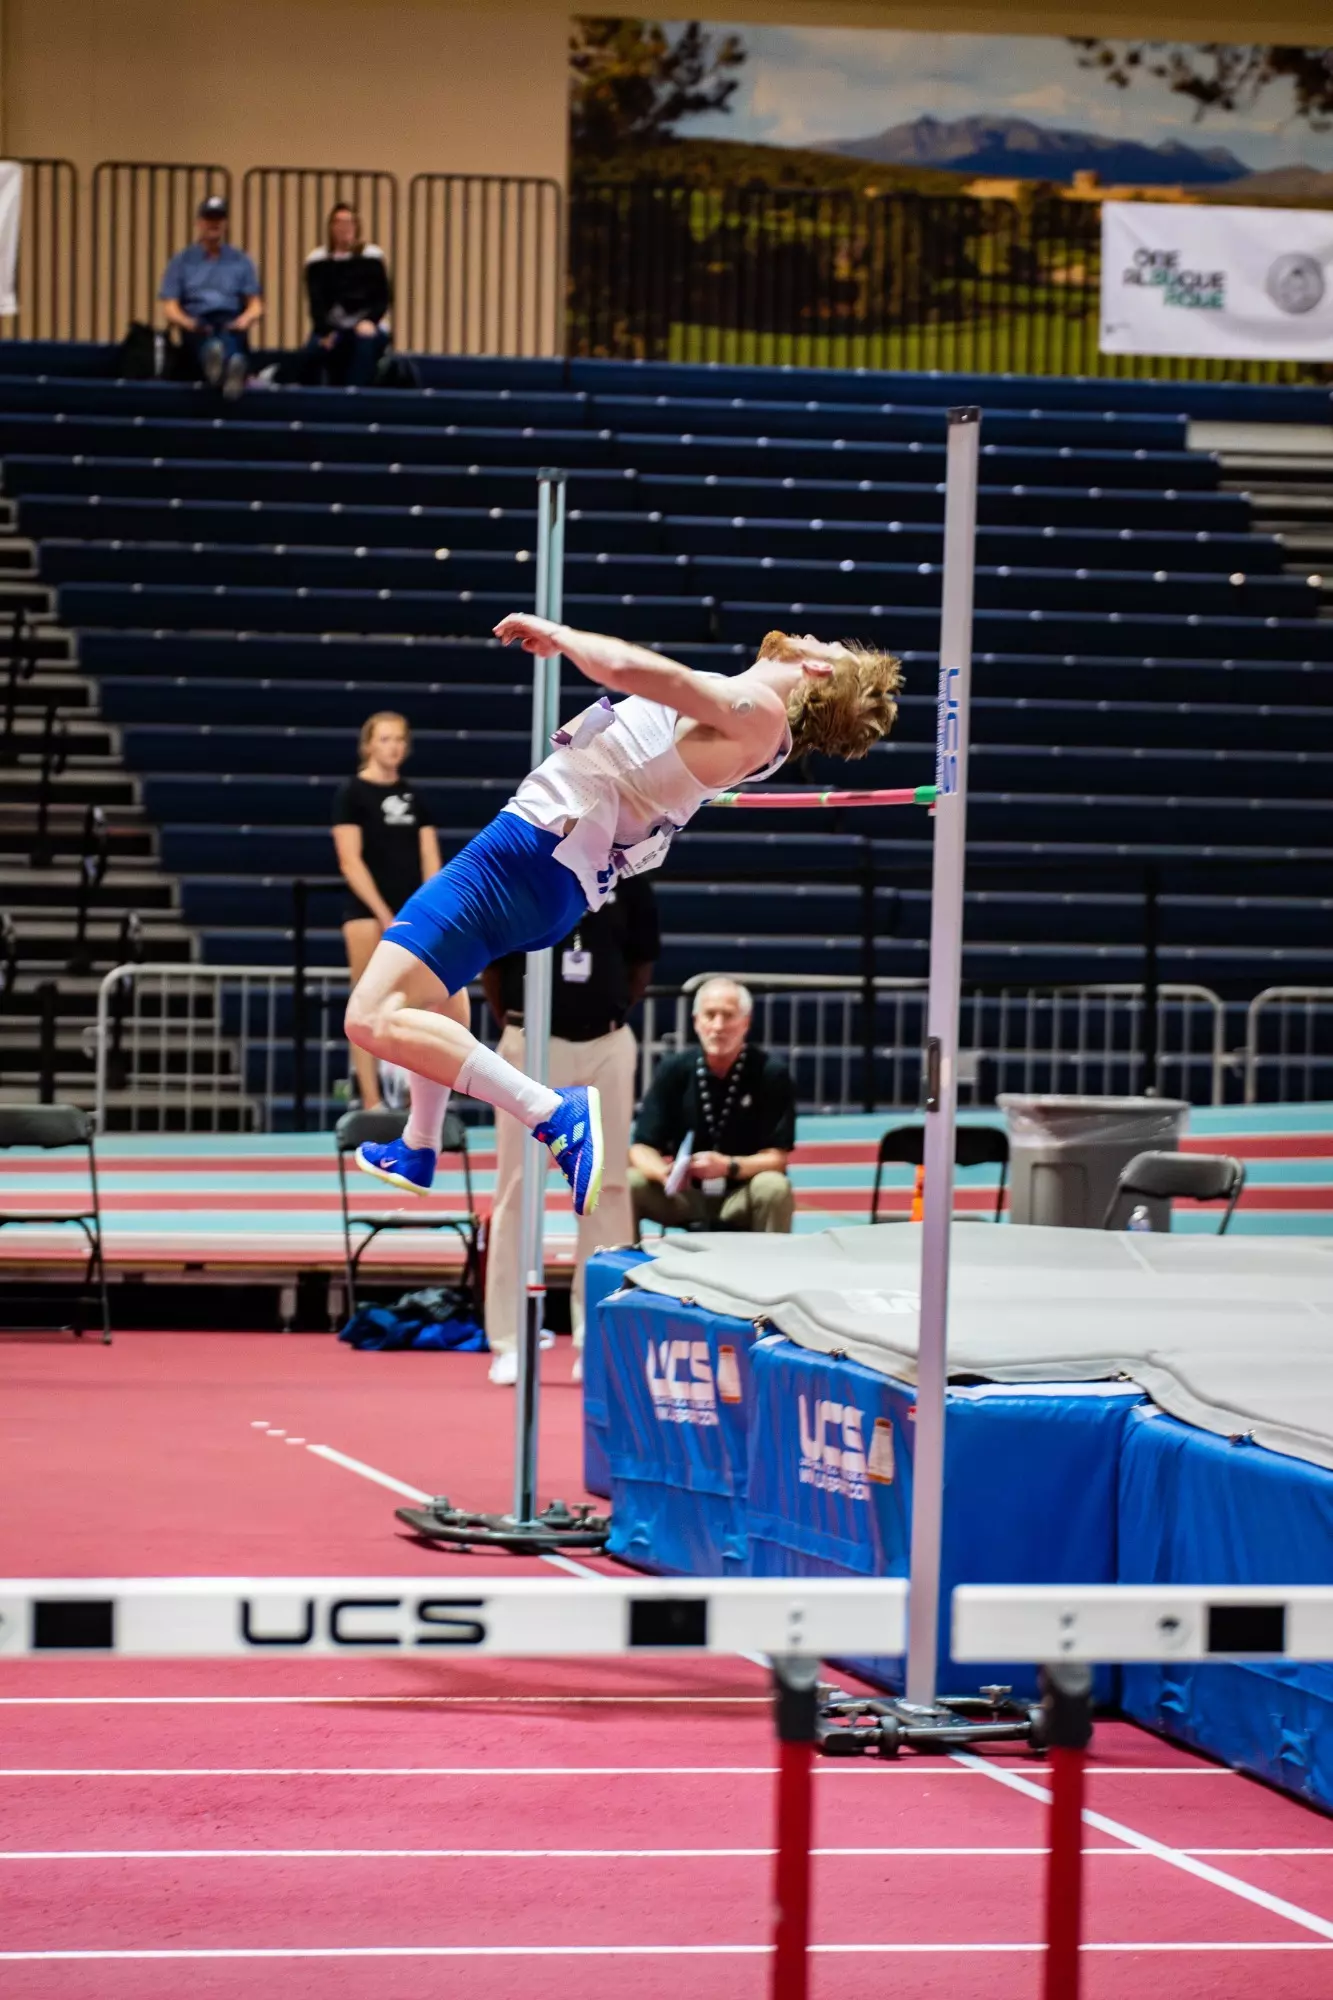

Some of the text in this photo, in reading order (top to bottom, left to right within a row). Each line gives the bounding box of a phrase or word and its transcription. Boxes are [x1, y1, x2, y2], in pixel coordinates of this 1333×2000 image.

[646, 1339, 715, 1400] UCS
[799, 1395, 866, 1475] UCS
[242, 1598, 486, 1645] UCS
